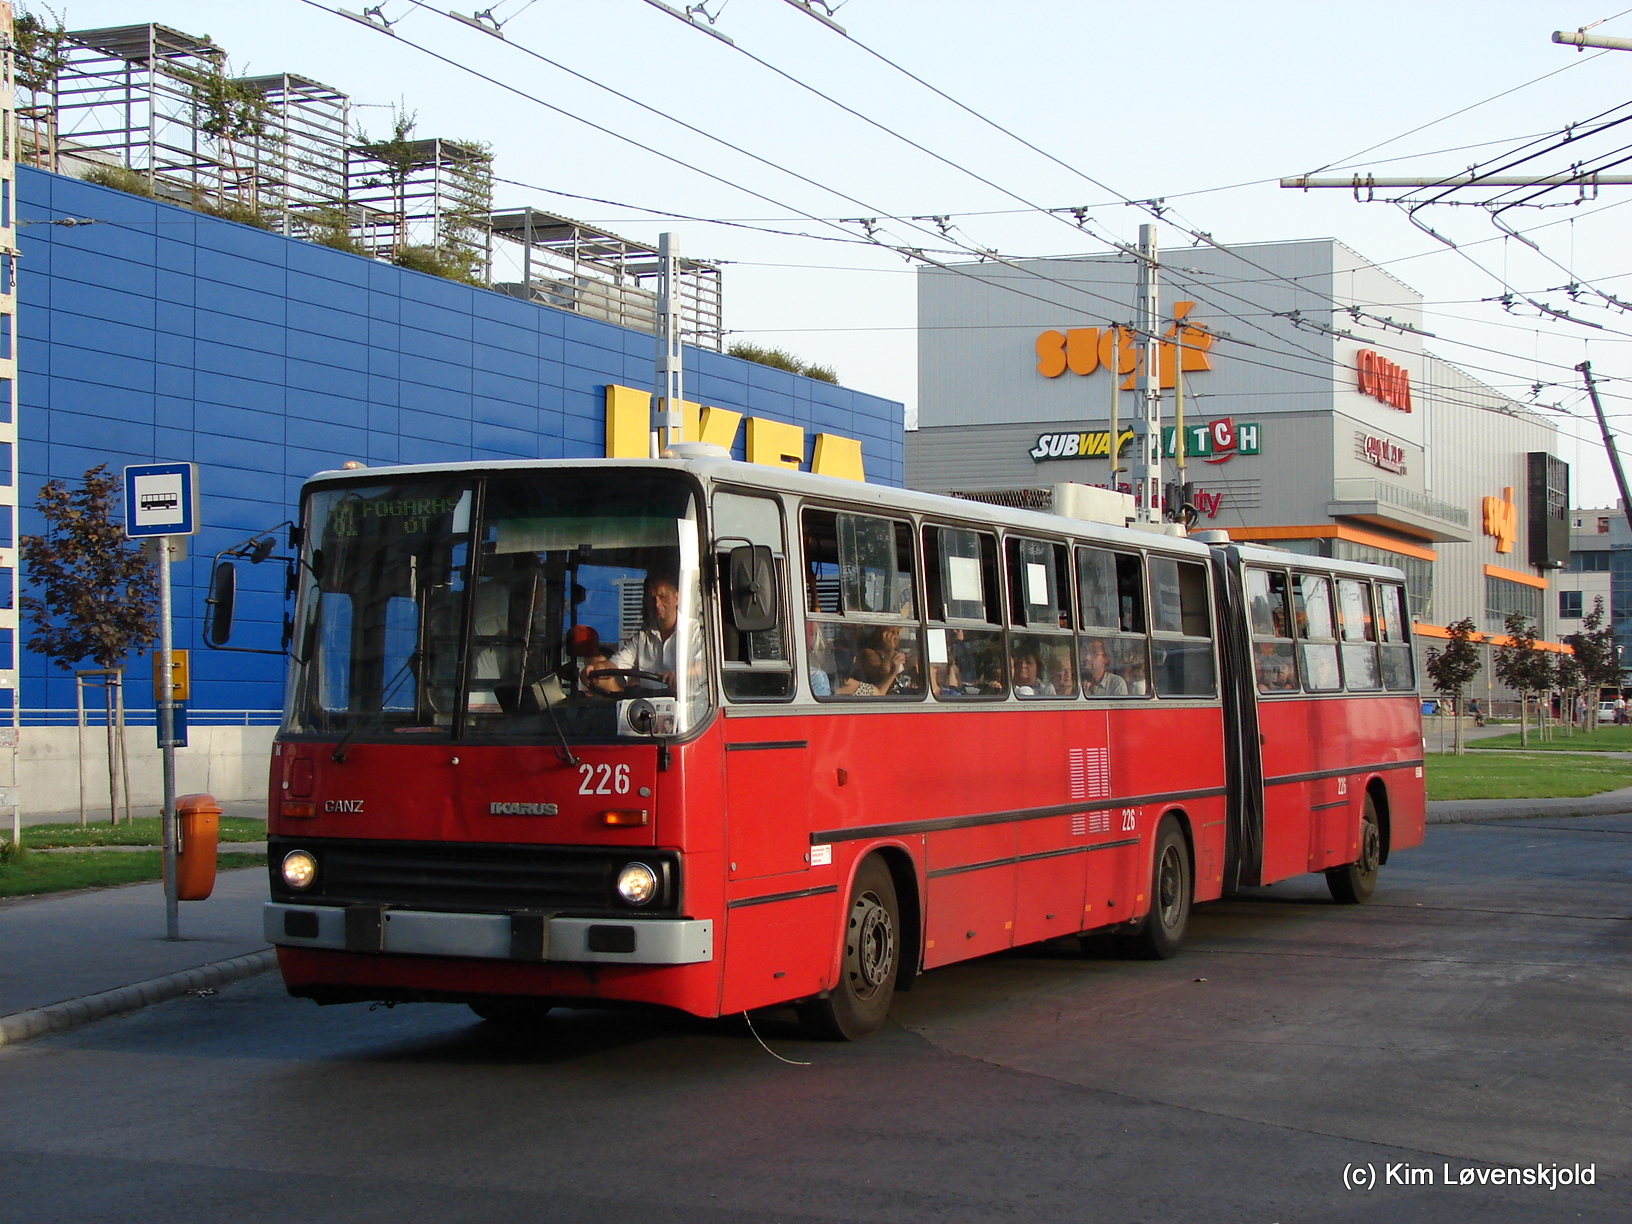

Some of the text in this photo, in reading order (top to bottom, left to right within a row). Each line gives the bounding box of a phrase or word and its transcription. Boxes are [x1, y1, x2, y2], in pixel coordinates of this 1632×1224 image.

[1028, 425, 1134, 463] SUBWAY
[578, 763, 630, 795] 226
[325, 800, 364, 813] GANZ
[490, 802, 558, 816] IKARUS
[1122, 808, 1136, 831] 226
